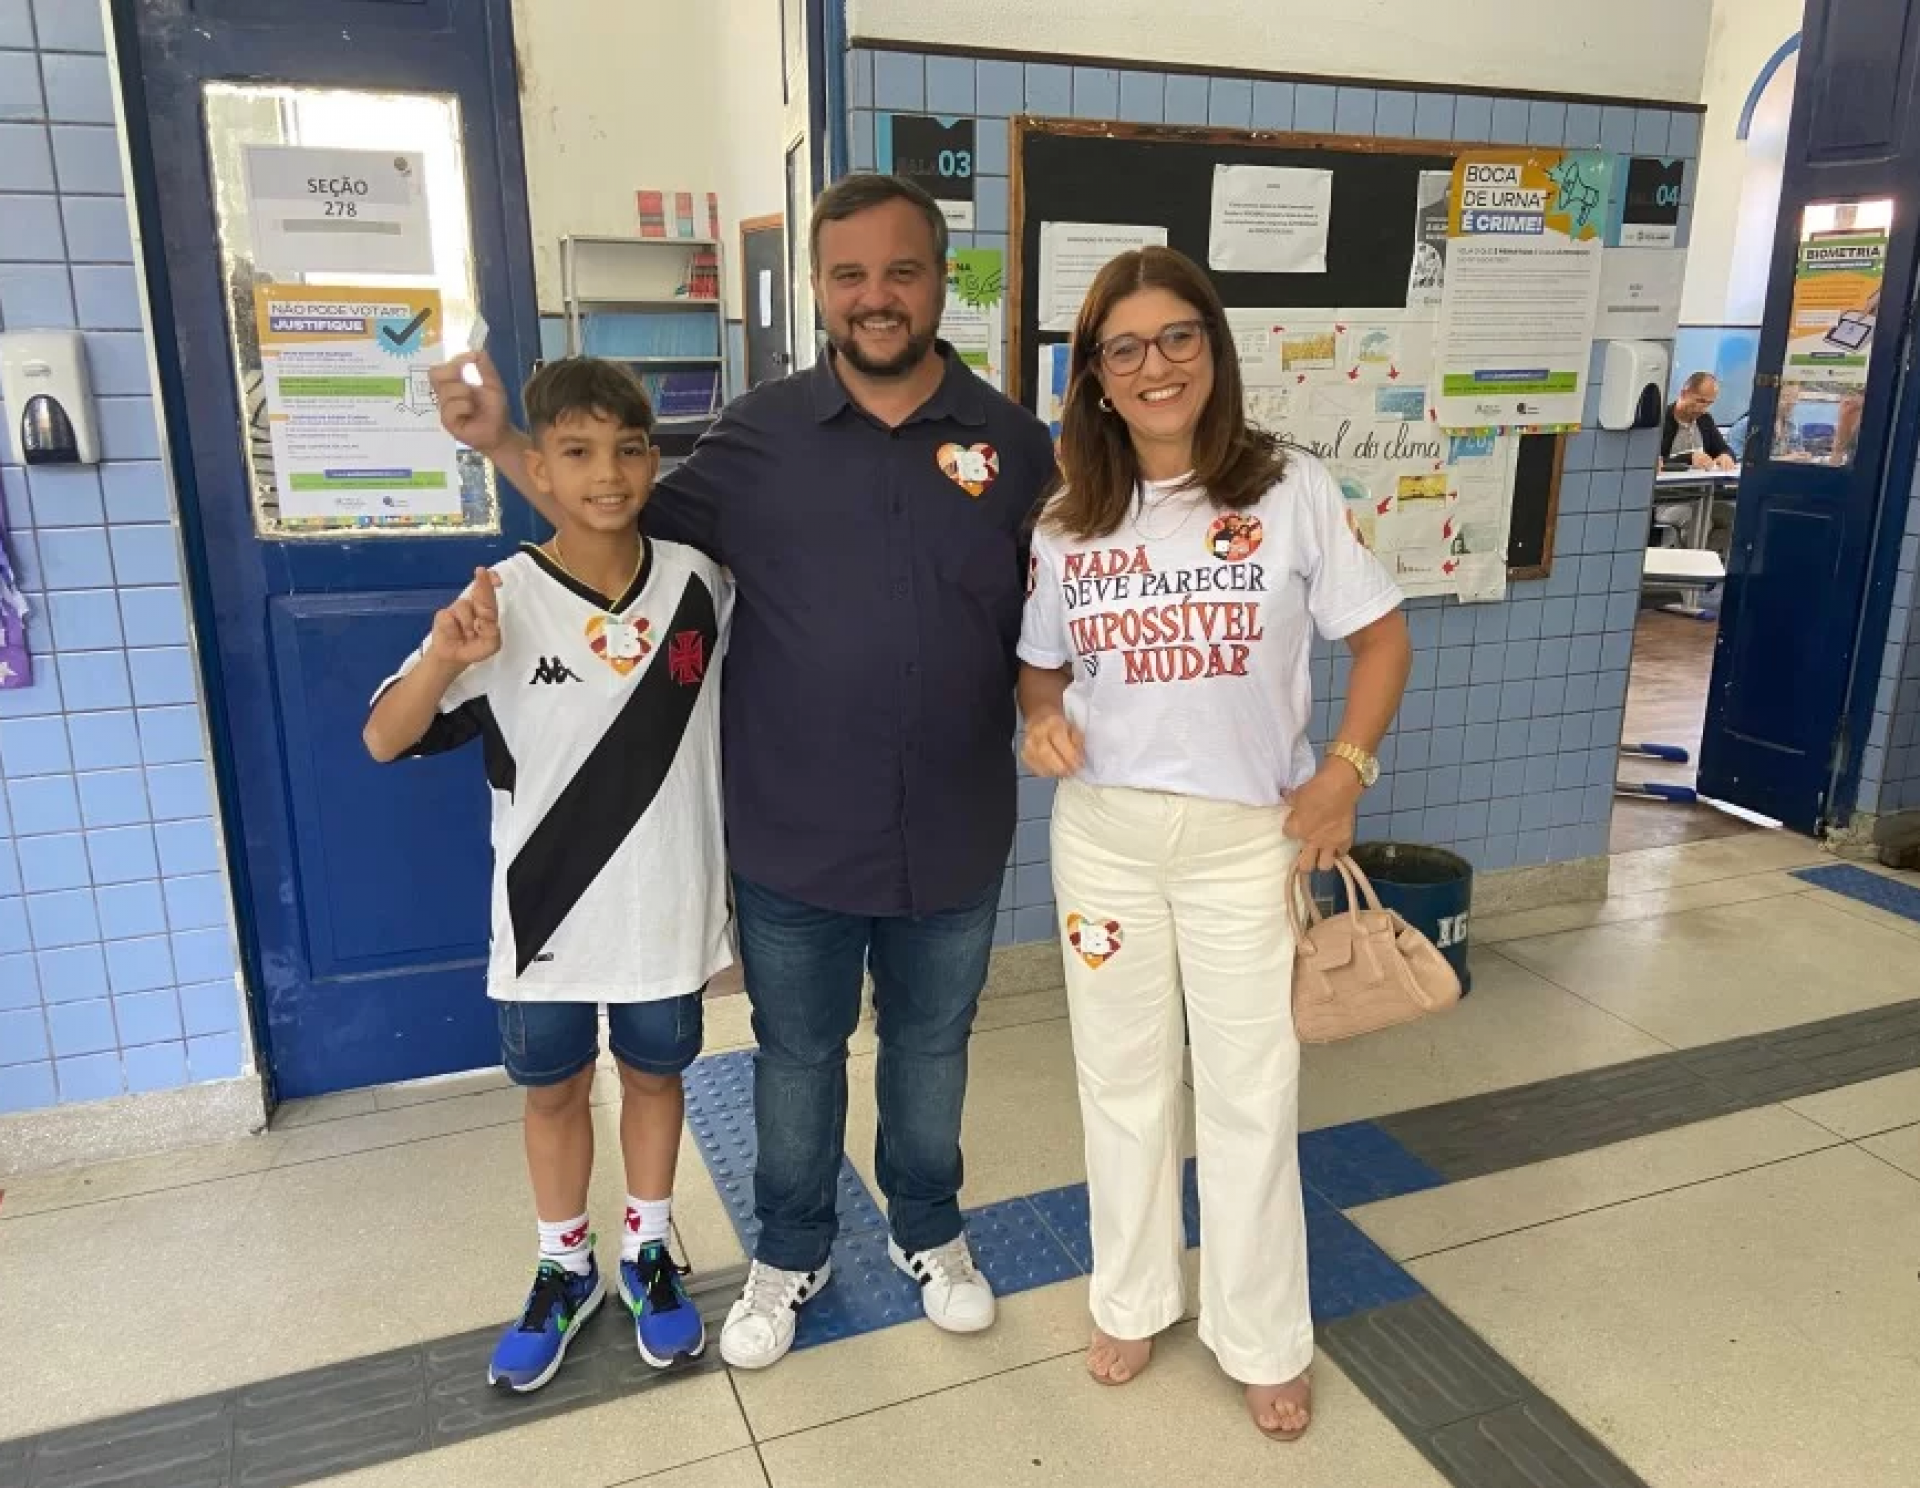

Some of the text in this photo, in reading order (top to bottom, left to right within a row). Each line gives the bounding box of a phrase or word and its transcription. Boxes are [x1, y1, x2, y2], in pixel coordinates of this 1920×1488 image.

[938, 150, 971, 177] 03
[1466, 166, 1517, 183] BOCA
[307, 176, 368, 197] SEÇÃO
[1656, 185, 1679, 206] 04
[325, 201, 357, 217] 278
[1463, 191, 1541, 206] DE URNA
[1463, 211, 1474, 231] É
[1476, 215, 1543, 231] CRIME!
[1806, 246, 1880, 260] BIOMETRIA
[271, 302, 306, 315] NÃO
[307, 305, 347, 315] PODE
[273, 319, 364, 331] JUSTIFIQUE
[1384, 422, 1440, 461] clima
[1063, 545, 1151, 581] NADA
[1063, 574, 1130, 609] DEVE
[1140, 563, 1266, 596] PARECER
[1069, 593, 1264, 656] IMPOSSÍVEL
[1124, 644, 1250, 685] MUDAR
